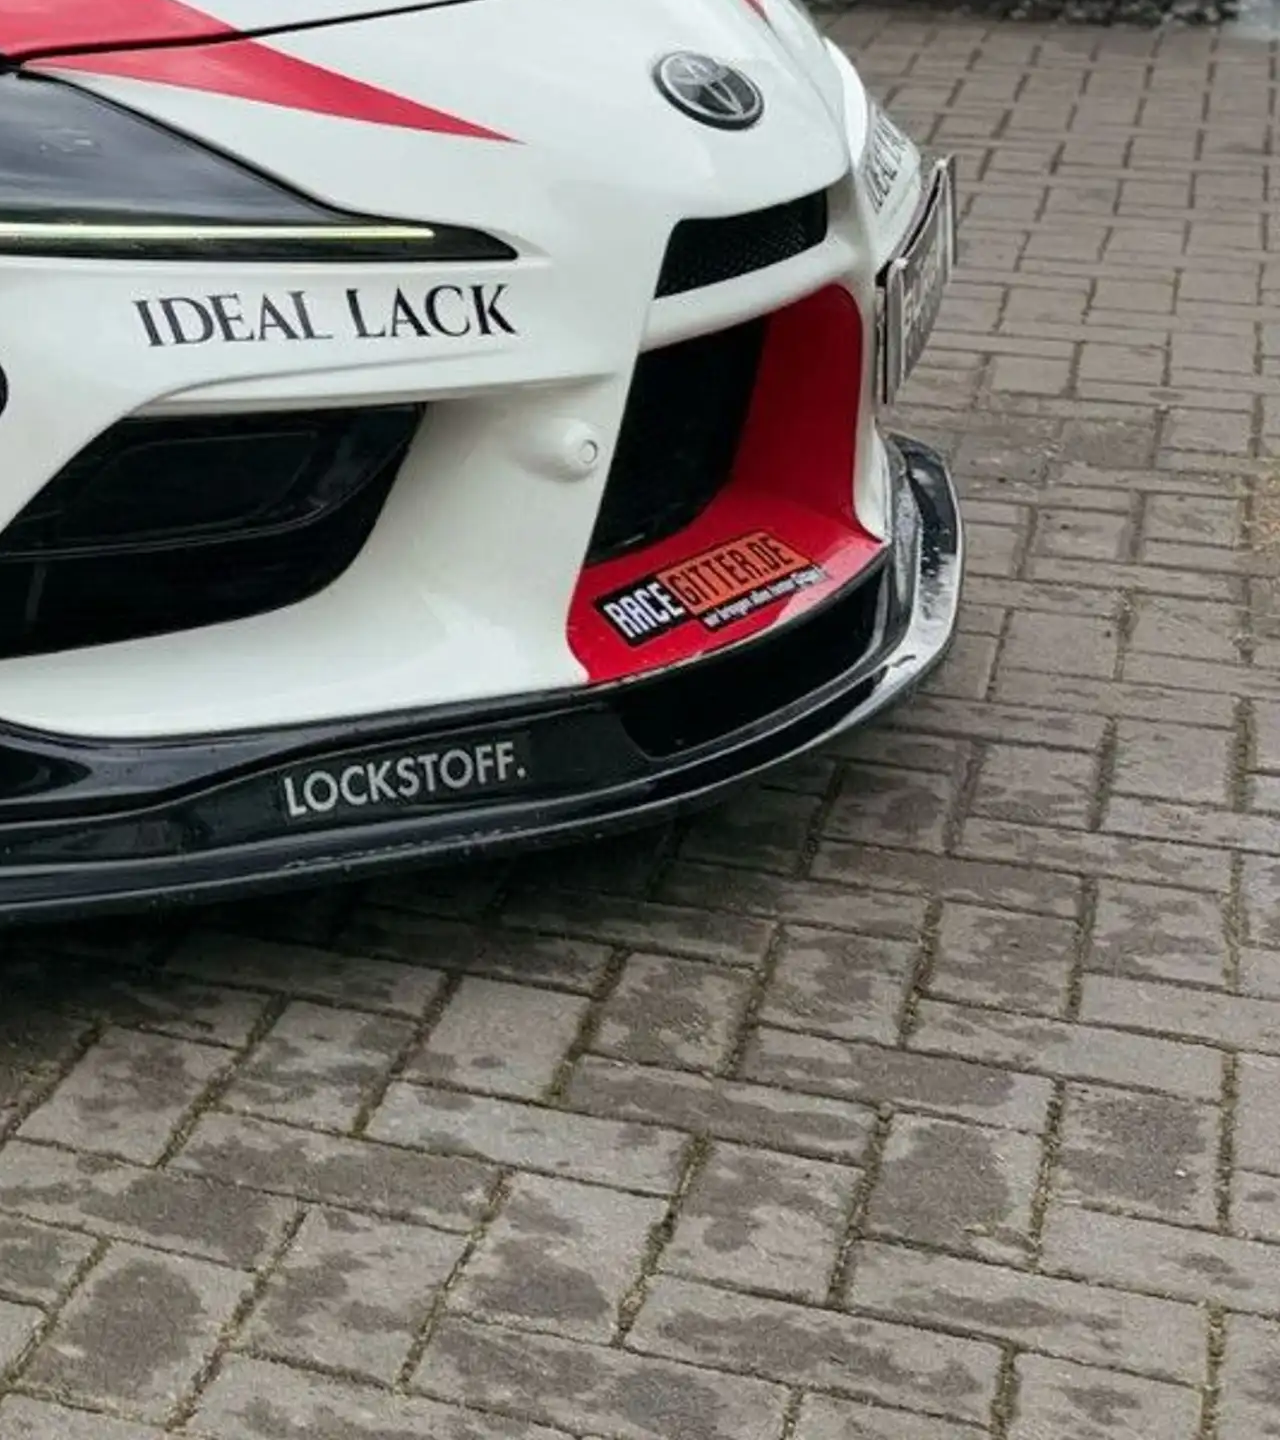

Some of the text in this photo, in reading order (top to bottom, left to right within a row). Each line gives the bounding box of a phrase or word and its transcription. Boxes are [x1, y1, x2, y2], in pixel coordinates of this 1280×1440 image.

[133, 283, 519, 348] IDEAL LACK
[283, 741, 526, 817] LOCKSTOFF.
